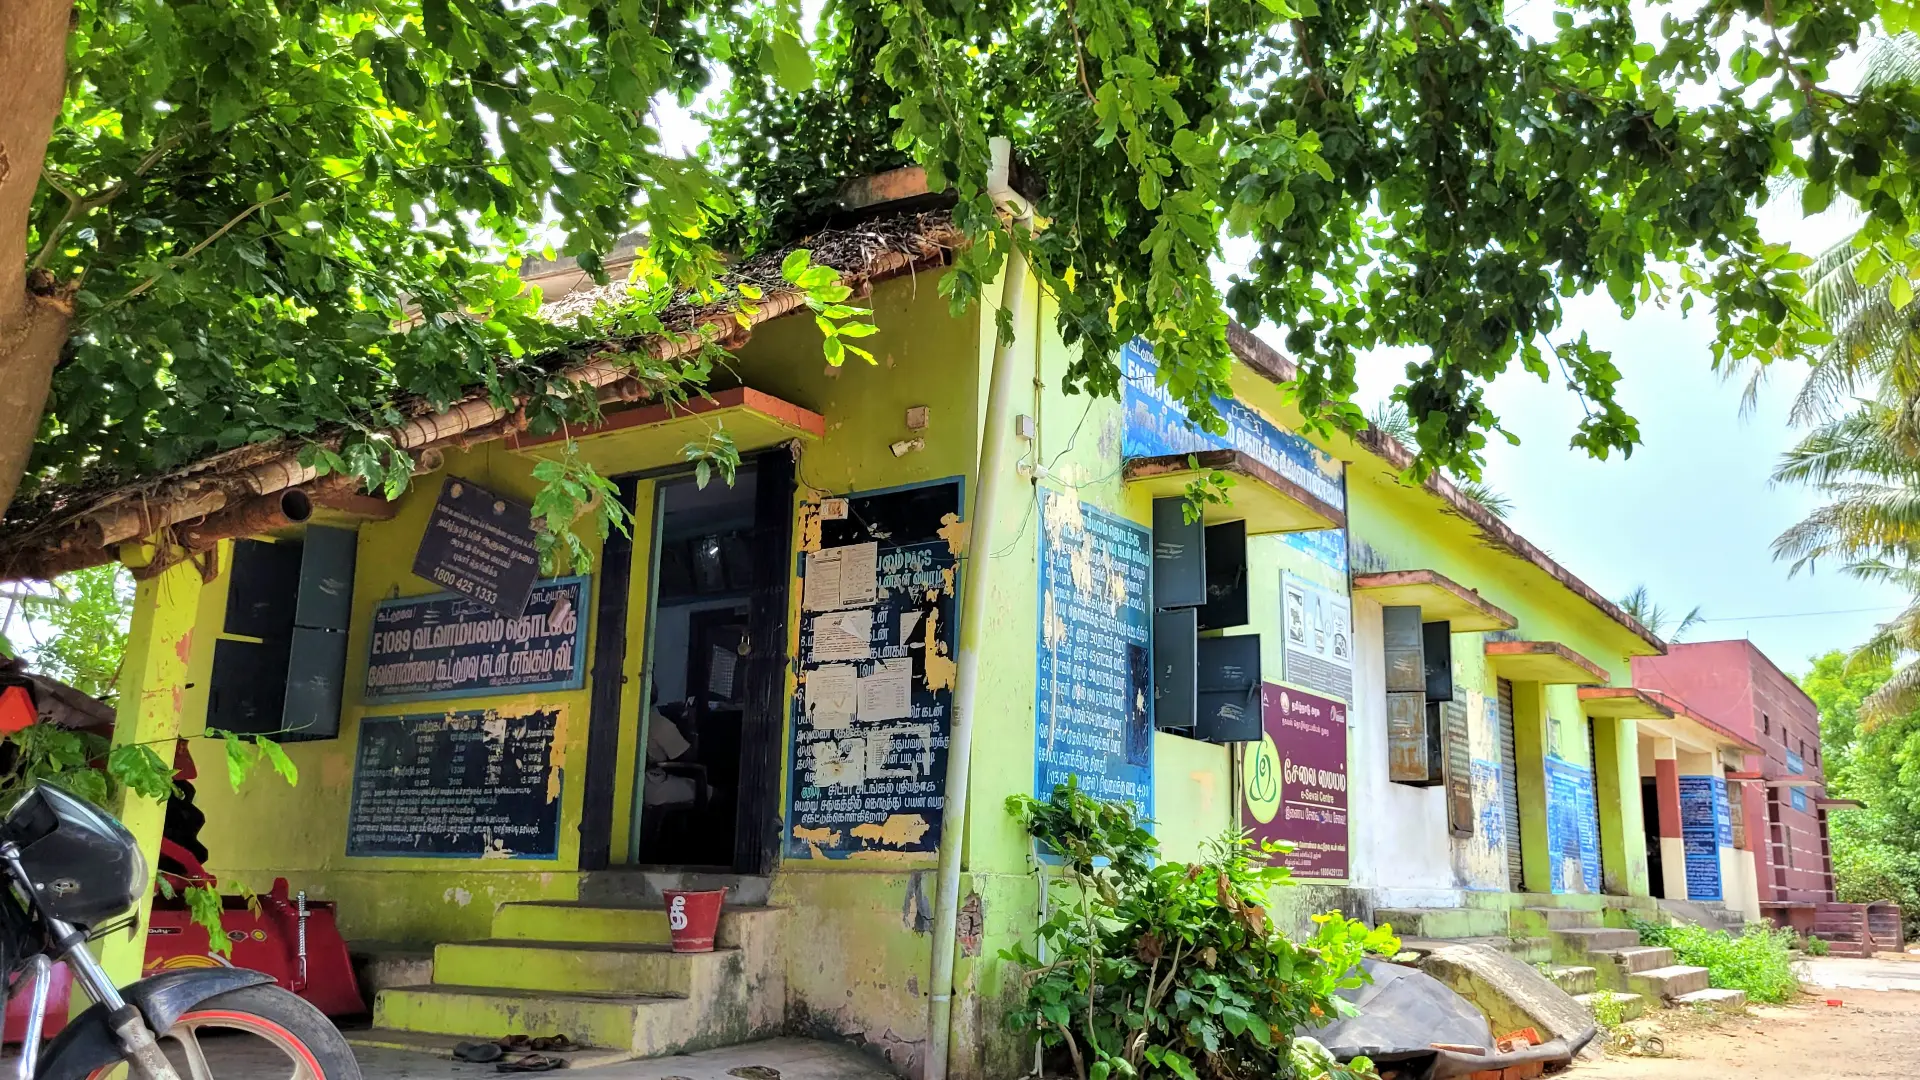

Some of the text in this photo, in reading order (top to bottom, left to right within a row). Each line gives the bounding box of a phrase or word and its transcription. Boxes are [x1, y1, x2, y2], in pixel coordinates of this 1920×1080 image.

[433, 566, 456, 585] 1800
[456, 577, 474, 594] 425
[474, 585, 498, 605] 1333
[412, 612, 504, 651] வடவாம்பலம்
[367, 652, 436, 688] வேளாண்மை
[435, 648, 480, 684] கூட்டுறவு
[480, 643, 509, 678] கடன்
[509, 640, 553, 676] சங்கம்
[1283, 758, 1347, 792] சேவை மையம்
[904, 793, 927, 808] பயன்
[1300, 788, 1335, 804] e-Sevai Centre
